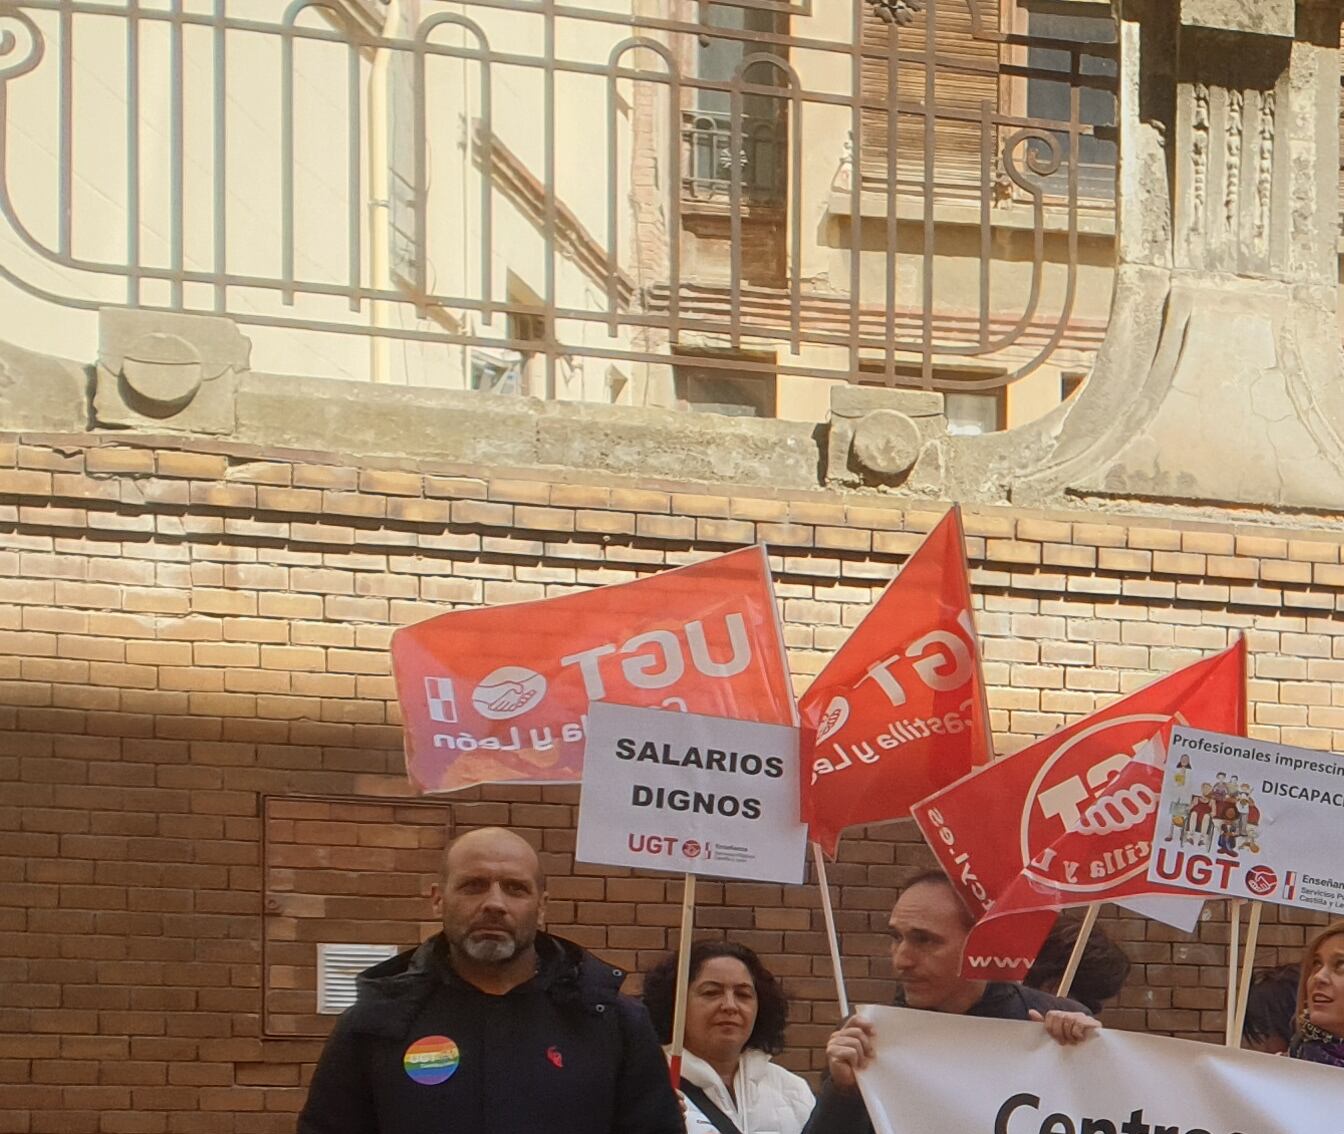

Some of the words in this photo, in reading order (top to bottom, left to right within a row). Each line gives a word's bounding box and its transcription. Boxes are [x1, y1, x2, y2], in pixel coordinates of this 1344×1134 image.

[615, 738, 784, 779] SALARIOS
[1172, 733, 1272, 764] Profesionales
[632, 784, 762, 820] DIGNOS
[628, 833, 678, 856] UGT
[1155, 848, 1240, 890] UGT
[1300, 887, 1335, 901] Servicios
